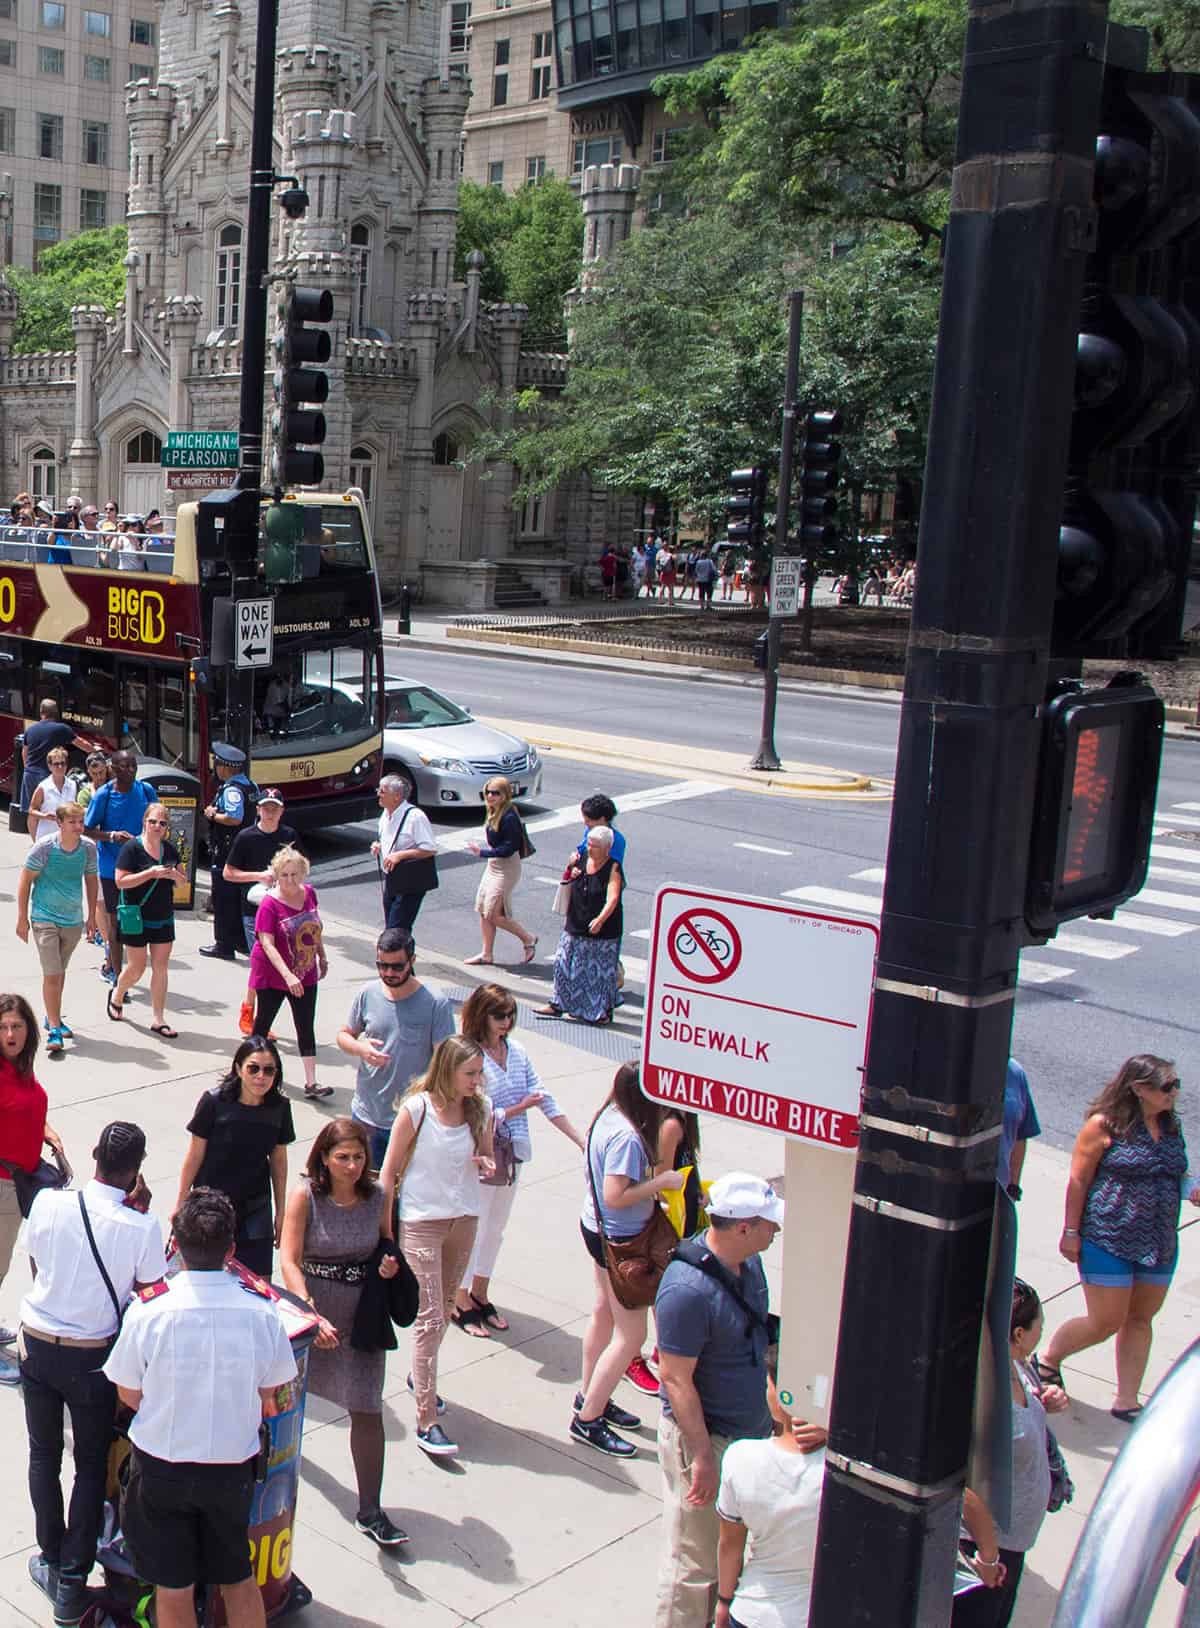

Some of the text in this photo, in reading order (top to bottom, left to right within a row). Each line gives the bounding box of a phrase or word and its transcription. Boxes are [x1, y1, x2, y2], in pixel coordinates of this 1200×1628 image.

[176, 434, 230, 449] MICHIGAN
[172, 449, 227, 465] PEARSON
[775, 560, 790, 573] LEFT
[776, 574, 796, 586] GREEN
[108, 586, 140, 615] BIG
[775, 587, 795, 598] ARROW
[777, 599, 792, 609] ONLY
[241, 605, 269, 622] ONE
[108, 615, 140, 642] BUS
[241, 623, 269, 641] WAY
[828, 924, 862, 934] CHICAGO
[661, 995, 690, 1018] ON
[660, 1019, 770, 1063] SIDEWALK
[657, 1069, 844, 1142] WALK YOUR BIKE
[249, 1527, 290, 1586] IG
